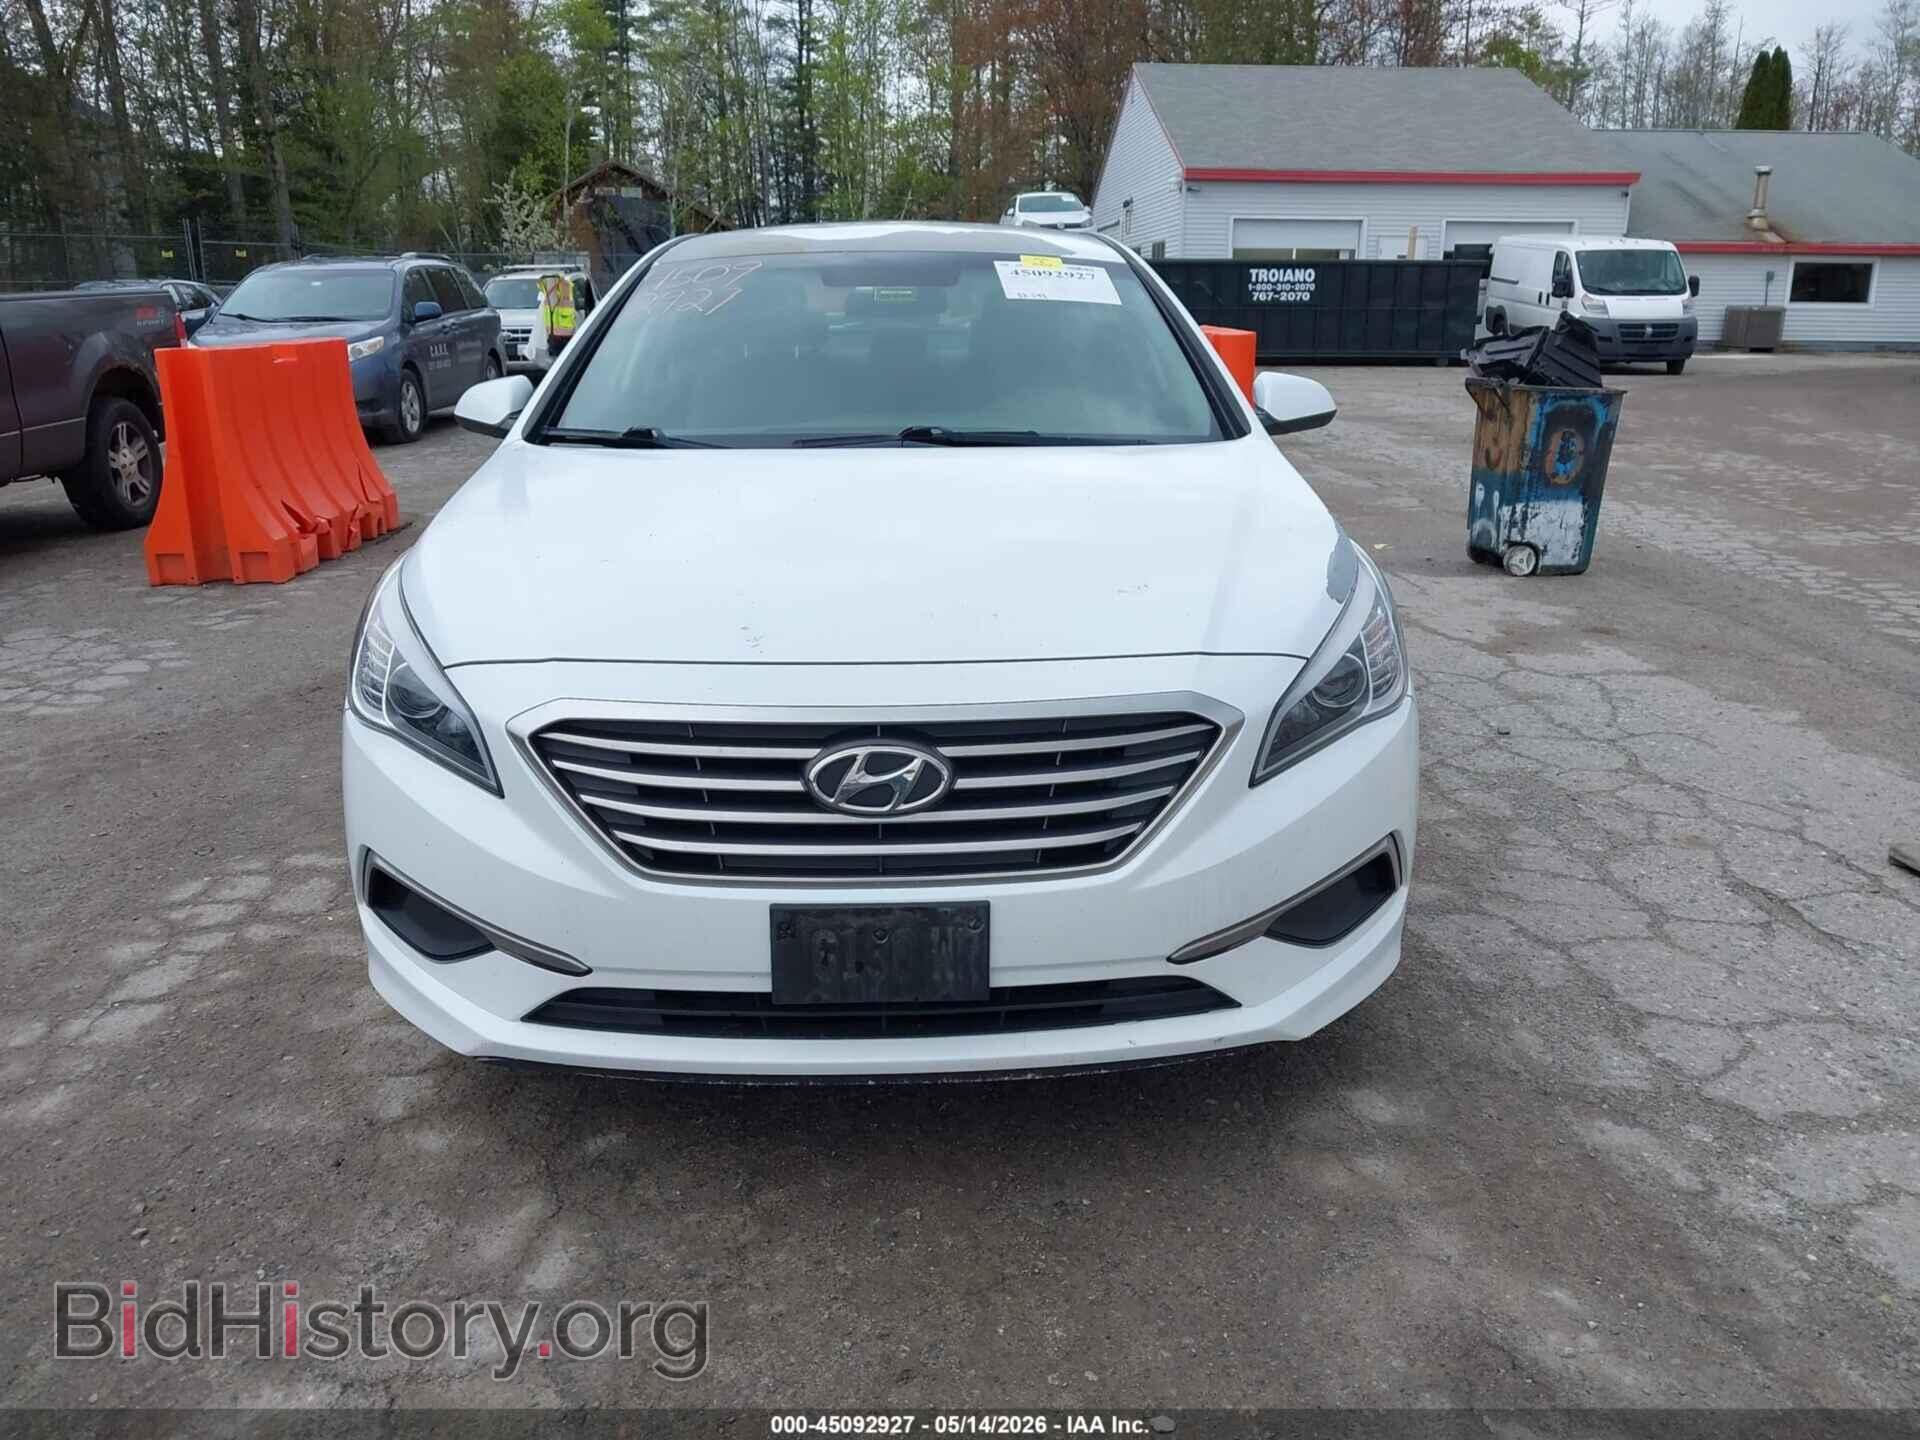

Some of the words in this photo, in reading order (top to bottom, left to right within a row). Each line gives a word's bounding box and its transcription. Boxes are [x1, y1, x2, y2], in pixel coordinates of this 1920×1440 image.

[1008, 269, 1096, 281] 45092927
[1249, 268, 1316, 282] TROIANO
[1252, 291, 1311, 301] 767-2070
